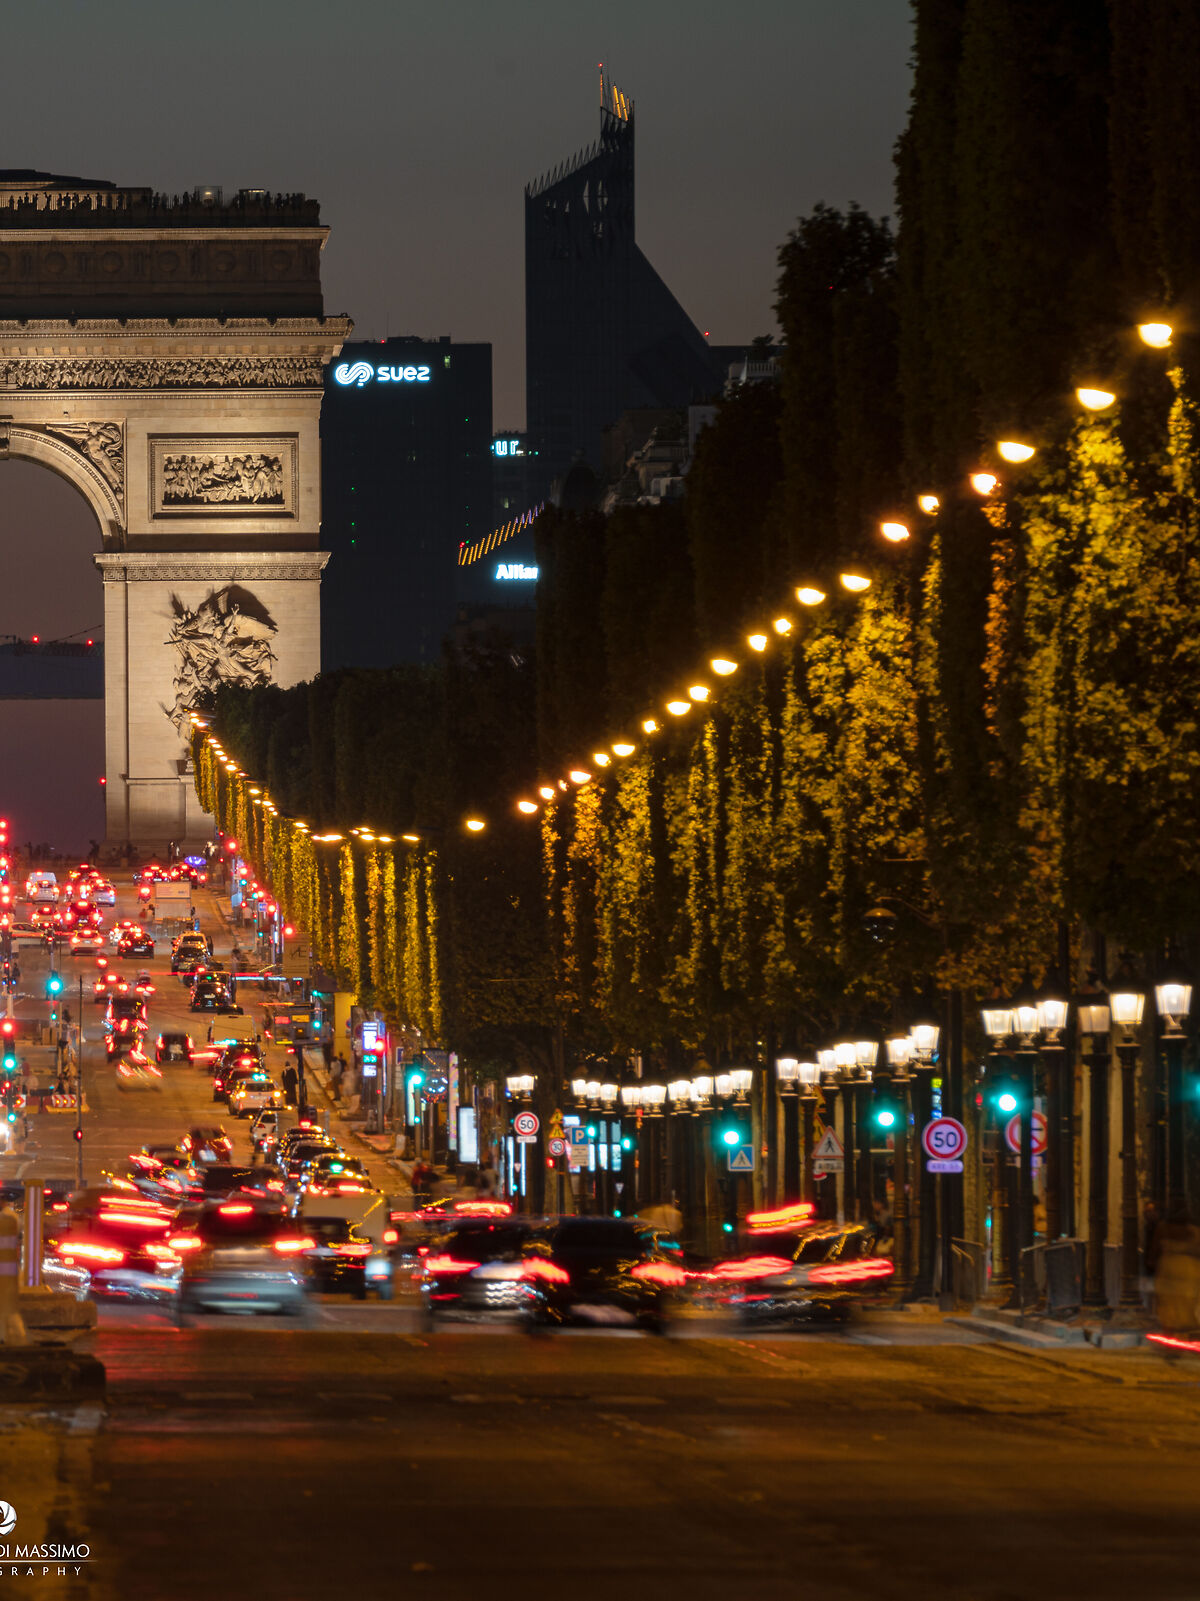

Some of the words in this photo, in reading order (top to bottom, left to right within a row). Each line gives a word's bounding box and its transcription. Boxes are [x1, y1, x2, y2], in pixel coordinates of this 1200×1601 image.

[377, 366, 430, 381] suez
[520, 1120, 534, 1129] 50
[576, 1130, 585, 1143] P
[934, 1131, 957, 1147] 50
[553, 1143, 562, 1151] 30
